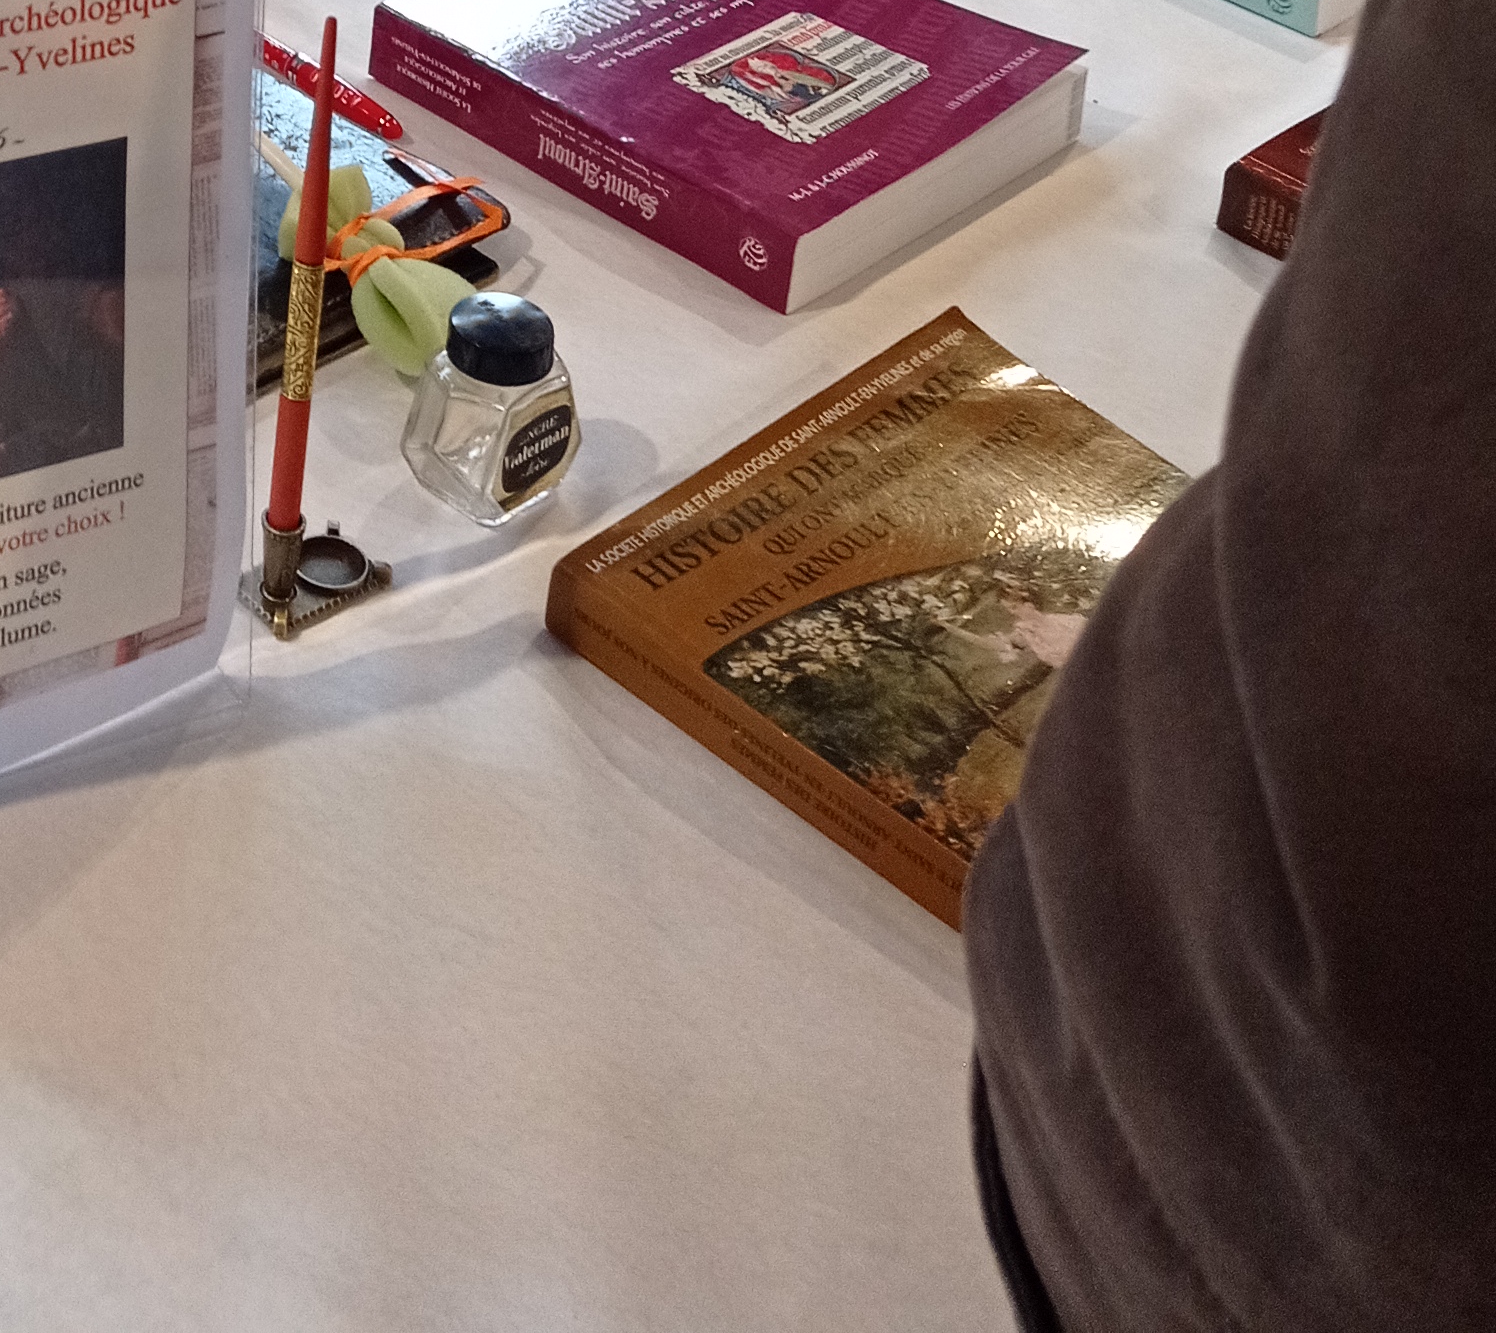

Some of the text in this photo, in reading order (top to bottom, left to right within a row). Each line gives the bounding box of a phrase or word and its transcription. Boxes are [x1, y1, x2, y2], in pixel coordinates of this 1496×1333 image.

[537, 134, 659, 220] Saint-Arnoul
[585, 559, 602, 574] LA
[640, 501, 698, 543] HISTORIQUE
[692, 491, 707, 511] ET
[704, 448, 786, 503] ARCHÉOLOGIQUE
[778, 438, 796, 459] DE
[909, 352, 922, 367] et
[919, 345, 934, 363] de
[52, 470, 145, 511] ancienne
[54, 507, 112, 541] choix
[630, 484, 797, 591] HISTOIRE
[786, 444, 859, 496] DES
[762, 526, 803, 557] QUI
[14, 559, 68, 594] sage,
